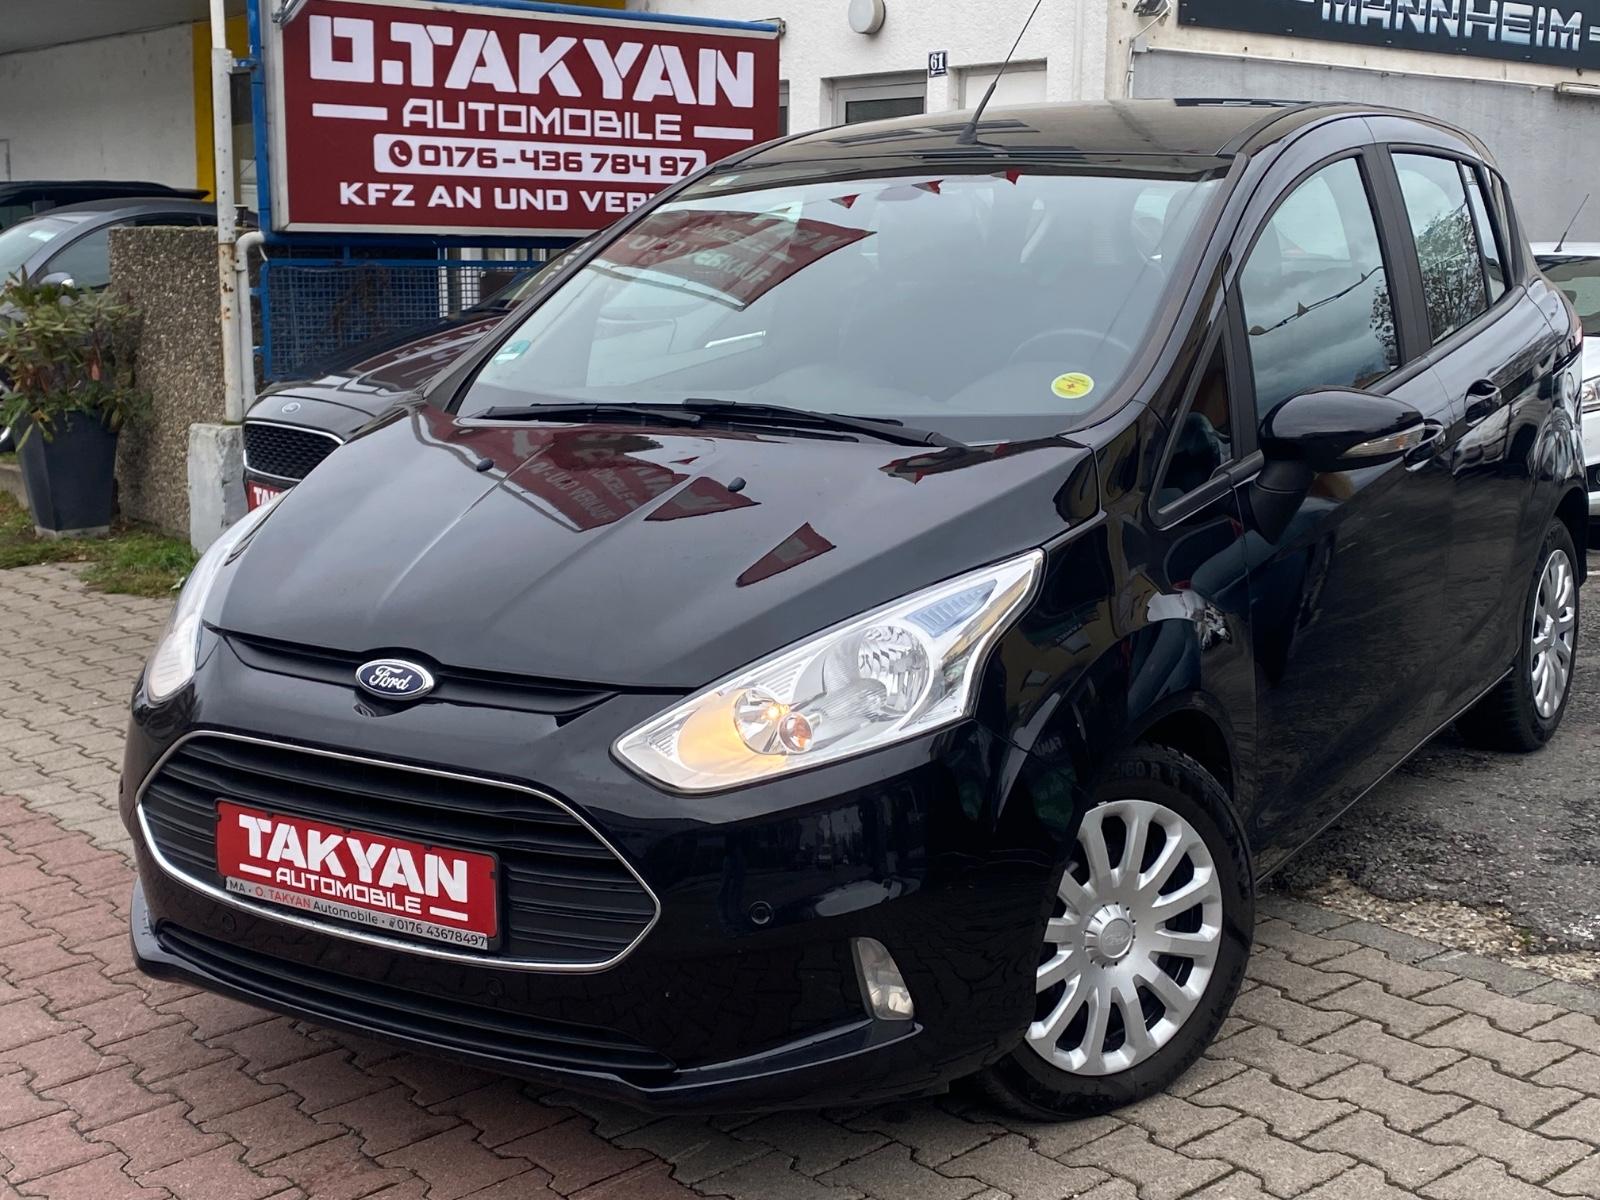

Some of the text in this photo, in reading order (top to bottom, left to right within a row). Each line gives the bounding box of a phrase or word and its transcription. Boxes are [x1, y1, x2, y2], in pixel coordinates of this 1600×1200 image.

[930, 52, 945, 70] 61
[402, 98, 682, 141] AUTOMOBILE
[591, 153, 650, 175] 784
[660, 157, 697, 176] 97
[340, 182, 655, 213] KFZ AN UND VER
[369, 665, 413, 690] Ford
[238, 814, 468, 903] TAKYAN
[276, 867, 422, 915] AUTOMOBILE
[229, 880, 246, 893] MA
[269, 889, 311, 909] TAKYAN
[313, 900, 379, 925] Automobile
[396, 919, 423, 935] 0176
[426, 926, 486, 947] 43678497
